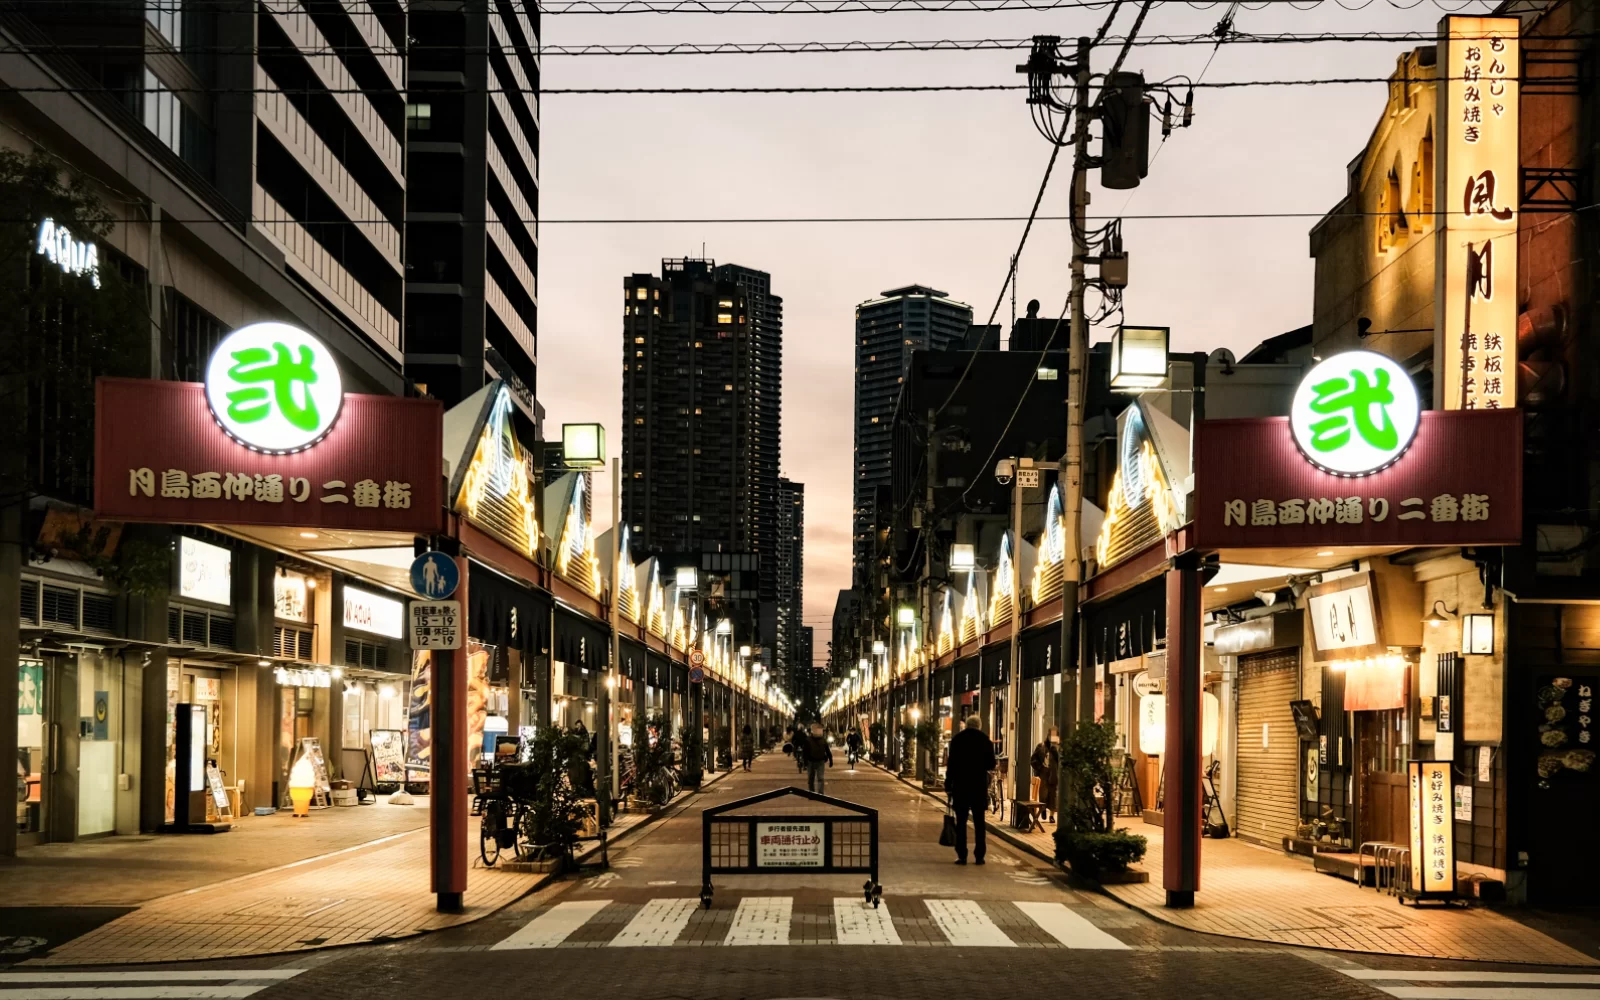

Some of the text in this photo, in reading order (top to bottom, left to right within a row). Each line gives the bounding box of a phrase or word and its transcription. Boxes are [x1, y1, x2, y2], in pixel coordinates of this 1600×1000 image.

[1463, 46, 1481, 142] お好み焼き
[1489, 36, 1505, 116] もんじゃ
[1464, 170, 1513, 300] 風月
[129, 467, 411, 509] 月島西仲通り二番街
[1224, 494, 1489, 526] 月島西仲通り二番街
[414, 606, 456, 616] 自転車を除く
[1578, 684, 1592, 743] ねぎやき
[760, 835, 821, 845] 車両通行止め
[1431, 770, 1446, 880] お好み焼き 鉄板焼き
